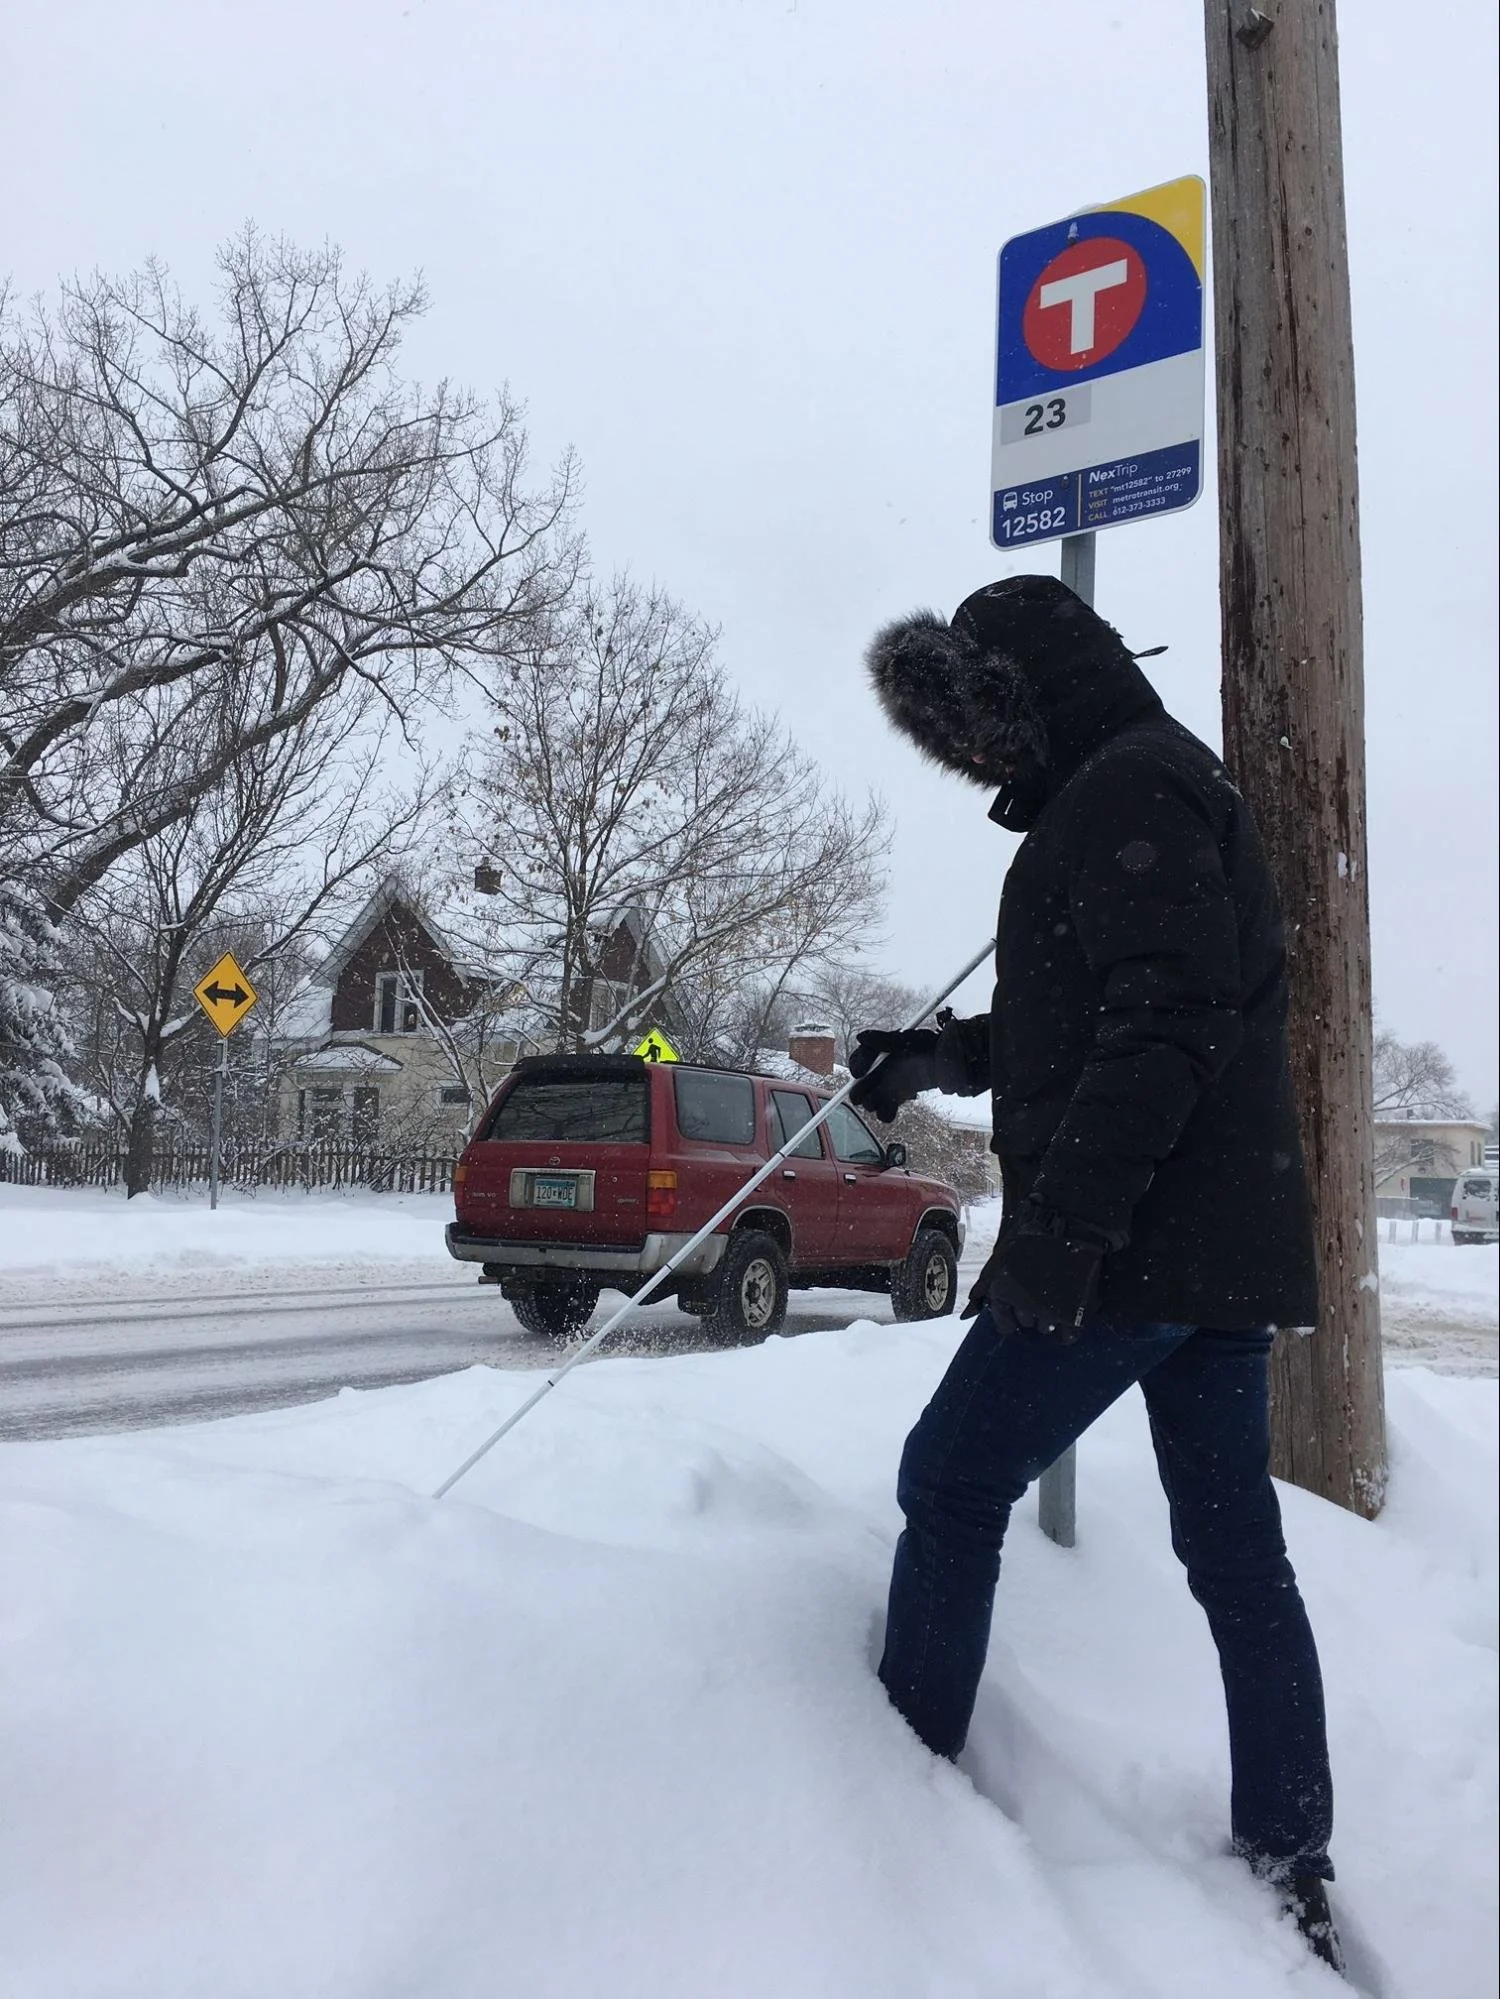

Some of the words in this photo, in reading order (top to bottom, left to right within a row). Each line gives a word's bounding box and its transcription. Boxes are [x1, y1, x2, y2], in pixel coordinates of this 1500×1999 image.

[1040, 258, 1127, 355] T
[1024, 398, 1066, 436] 23
[1089, 463, 1138, 483] NexTrip
[1089, 488, 1108, 498] TEXT
[1155, 475, 1164, 483] to
[1166, 466, 1192, 480] 27299
[1021, 489, 1053, 506] Stop
[1088, 499, 1108, 509] VISIT
[1112, 483, 1179, 504] metrotransit.org
[1088, 511, 1107, 521] CALL
[1112, 496, 1166, 516] 612-373-3333
[1002, 506, 1066, 538] 12582
